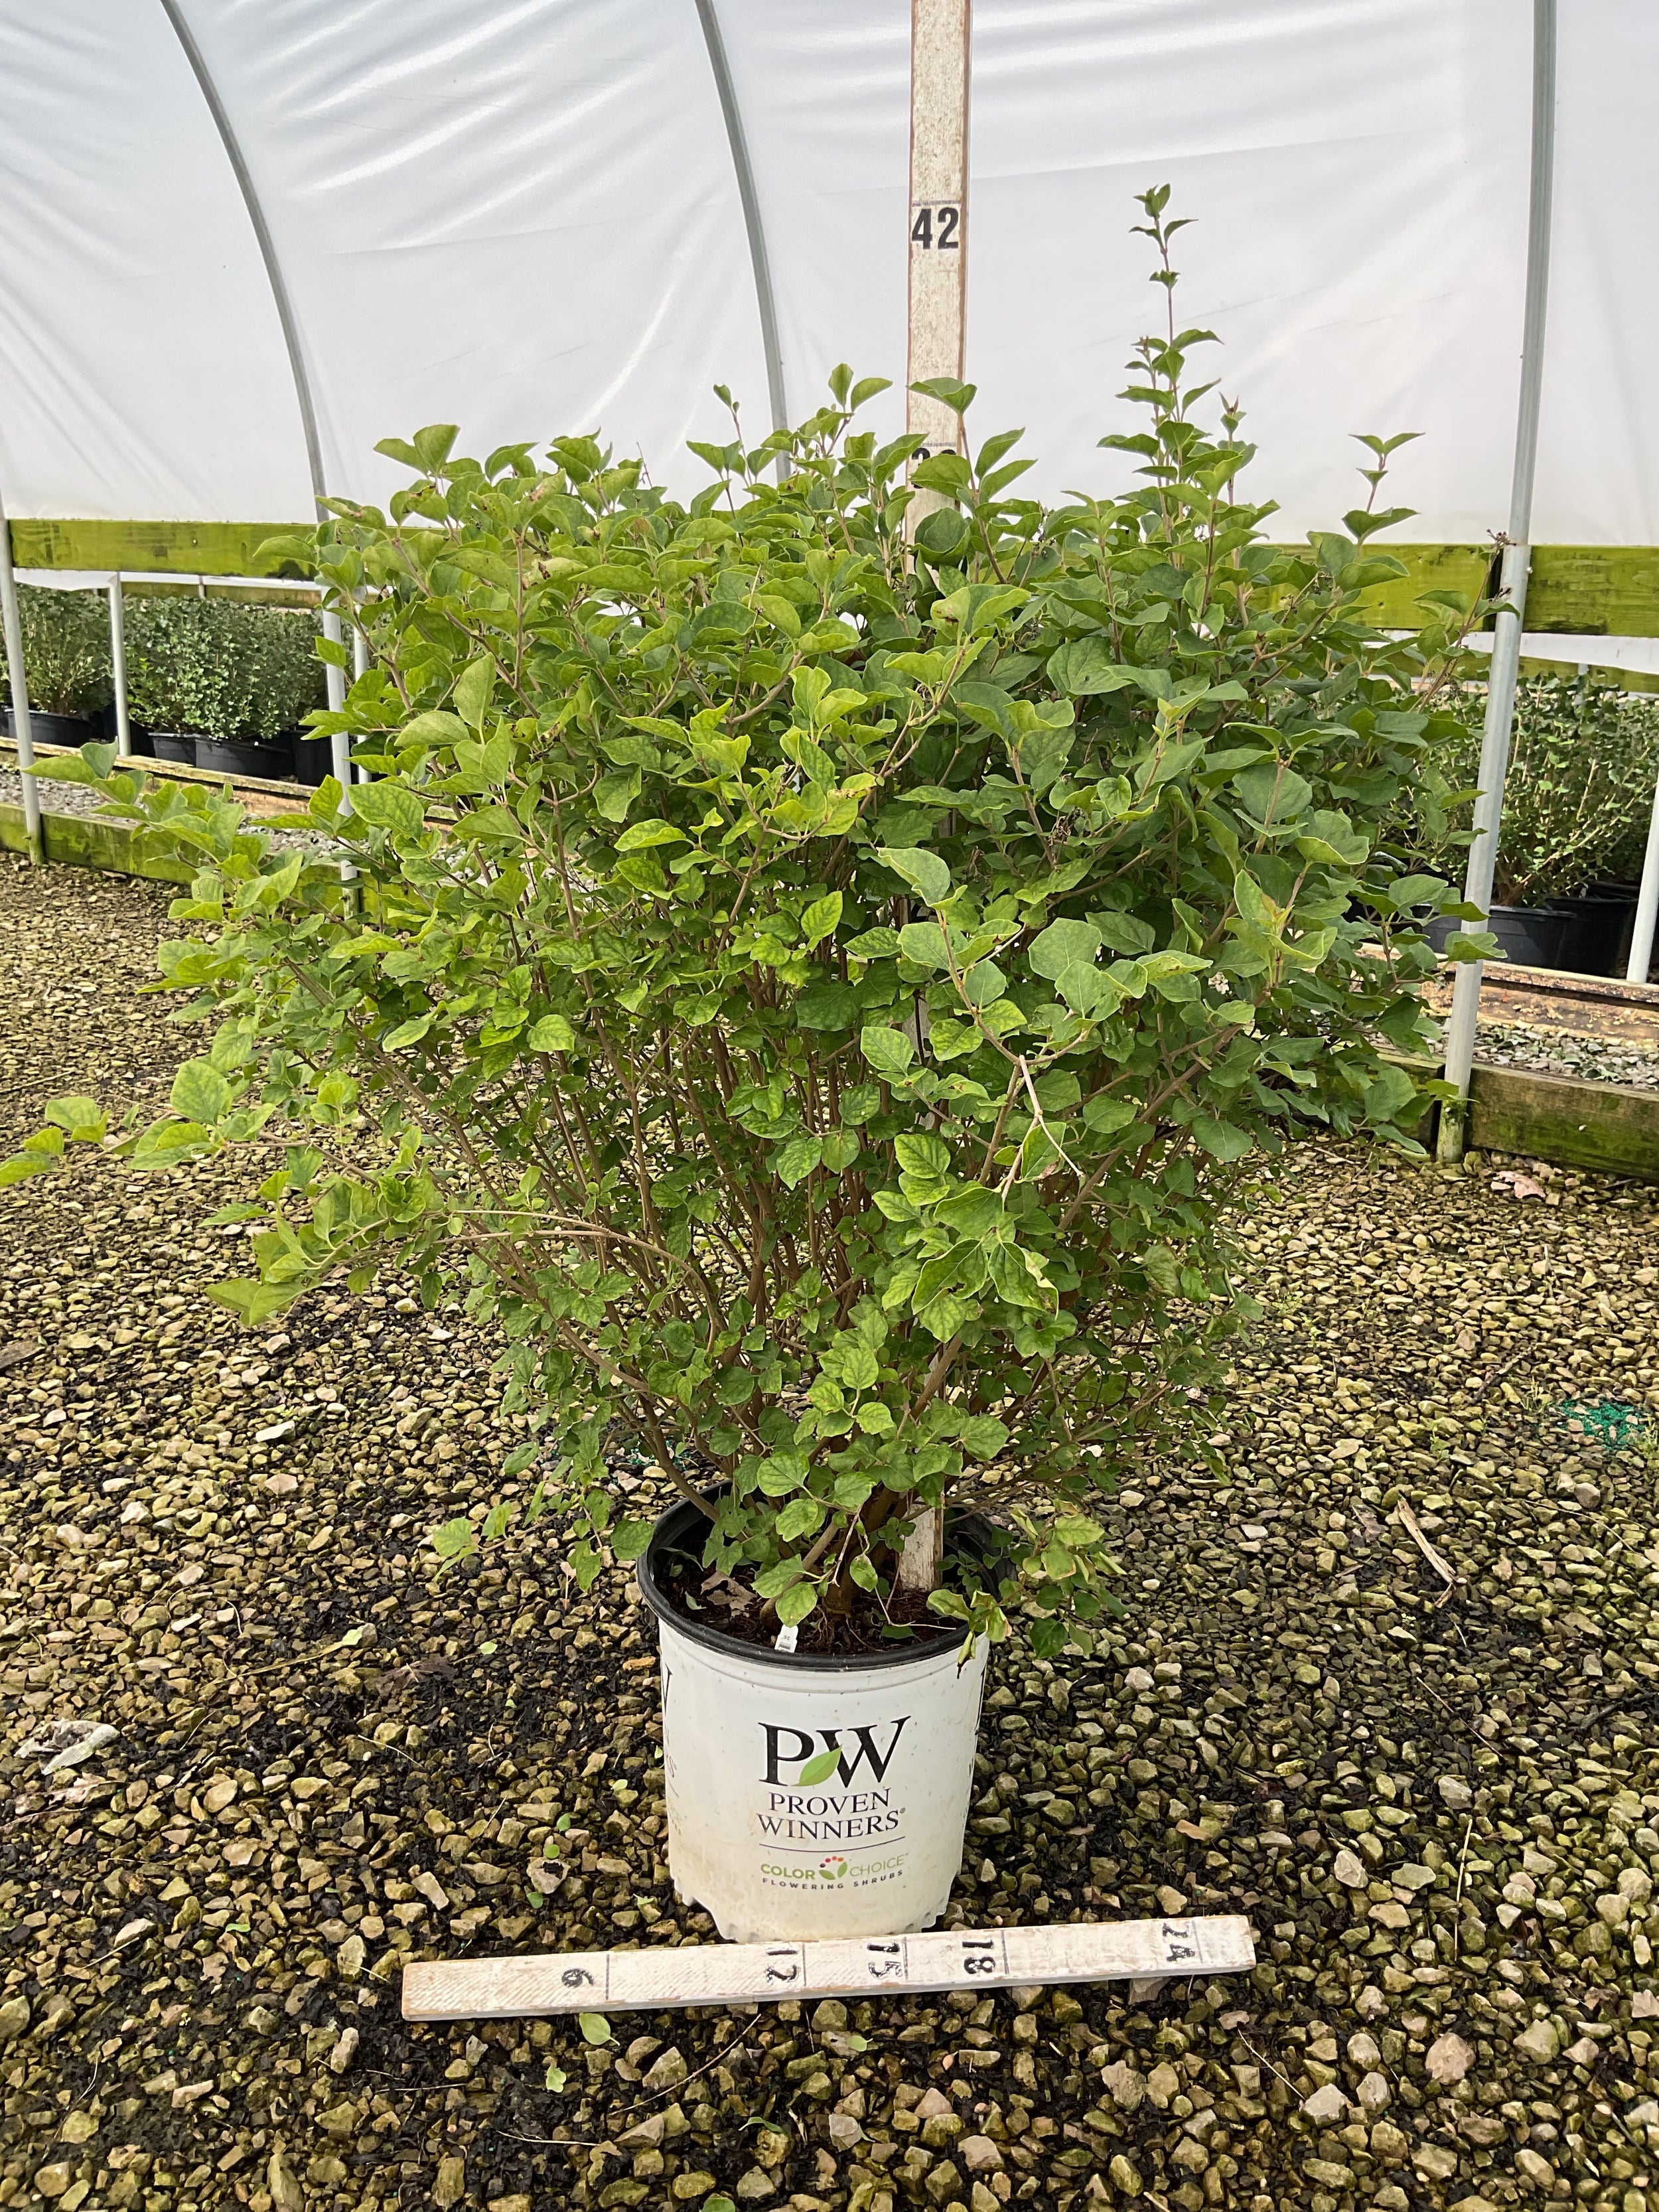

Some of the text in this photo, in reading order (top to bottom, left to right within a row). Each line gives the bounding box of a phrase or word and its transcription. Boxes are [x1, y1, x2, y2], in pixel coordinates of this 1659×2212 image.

[911, 207, 960, 250] 42
[758, 1716, 912, 1788] PW
[768, 1787, 892, 1816] PROVEN
[760, 1863, 816, 1880] COLOR
[762, 1870, 904, 1890] FLOWERING SHRUBS
[867, 1940, 903, 1979] 15
[962, 1938, 996, 1974] 18
[1162, 1921, 1195, 1962] 24
[561, 1968, 595, 1989] 6
[765, 1948, 802, 1985] 12
